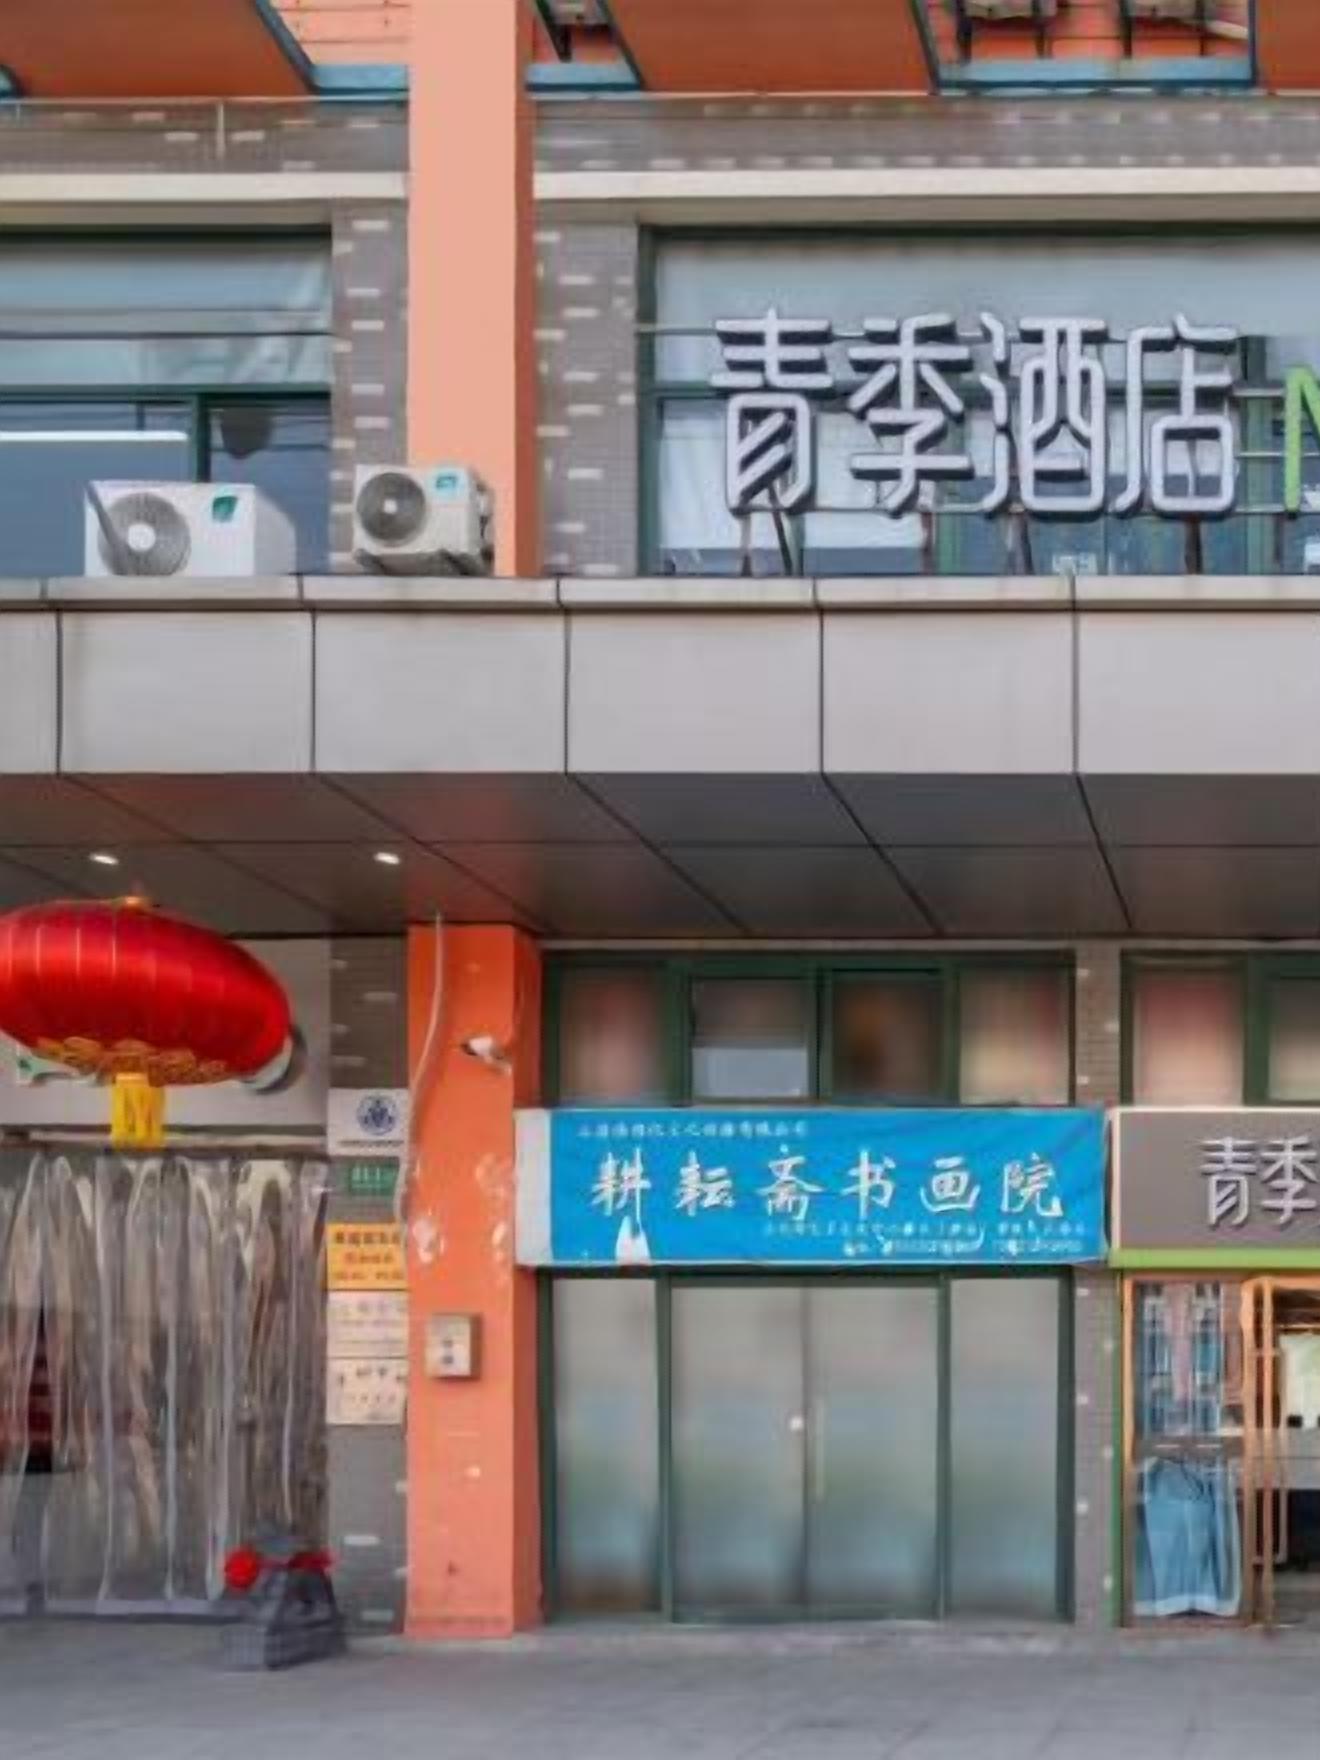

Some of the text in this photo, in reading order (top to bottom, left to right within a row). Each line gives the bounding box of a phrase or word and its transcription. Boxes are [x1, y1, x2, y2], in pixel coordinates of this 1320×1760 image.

[710, 311, 1237, 517] 青季酒店
[590, 1145, 1065, 1219] 耕耘斋书画院
